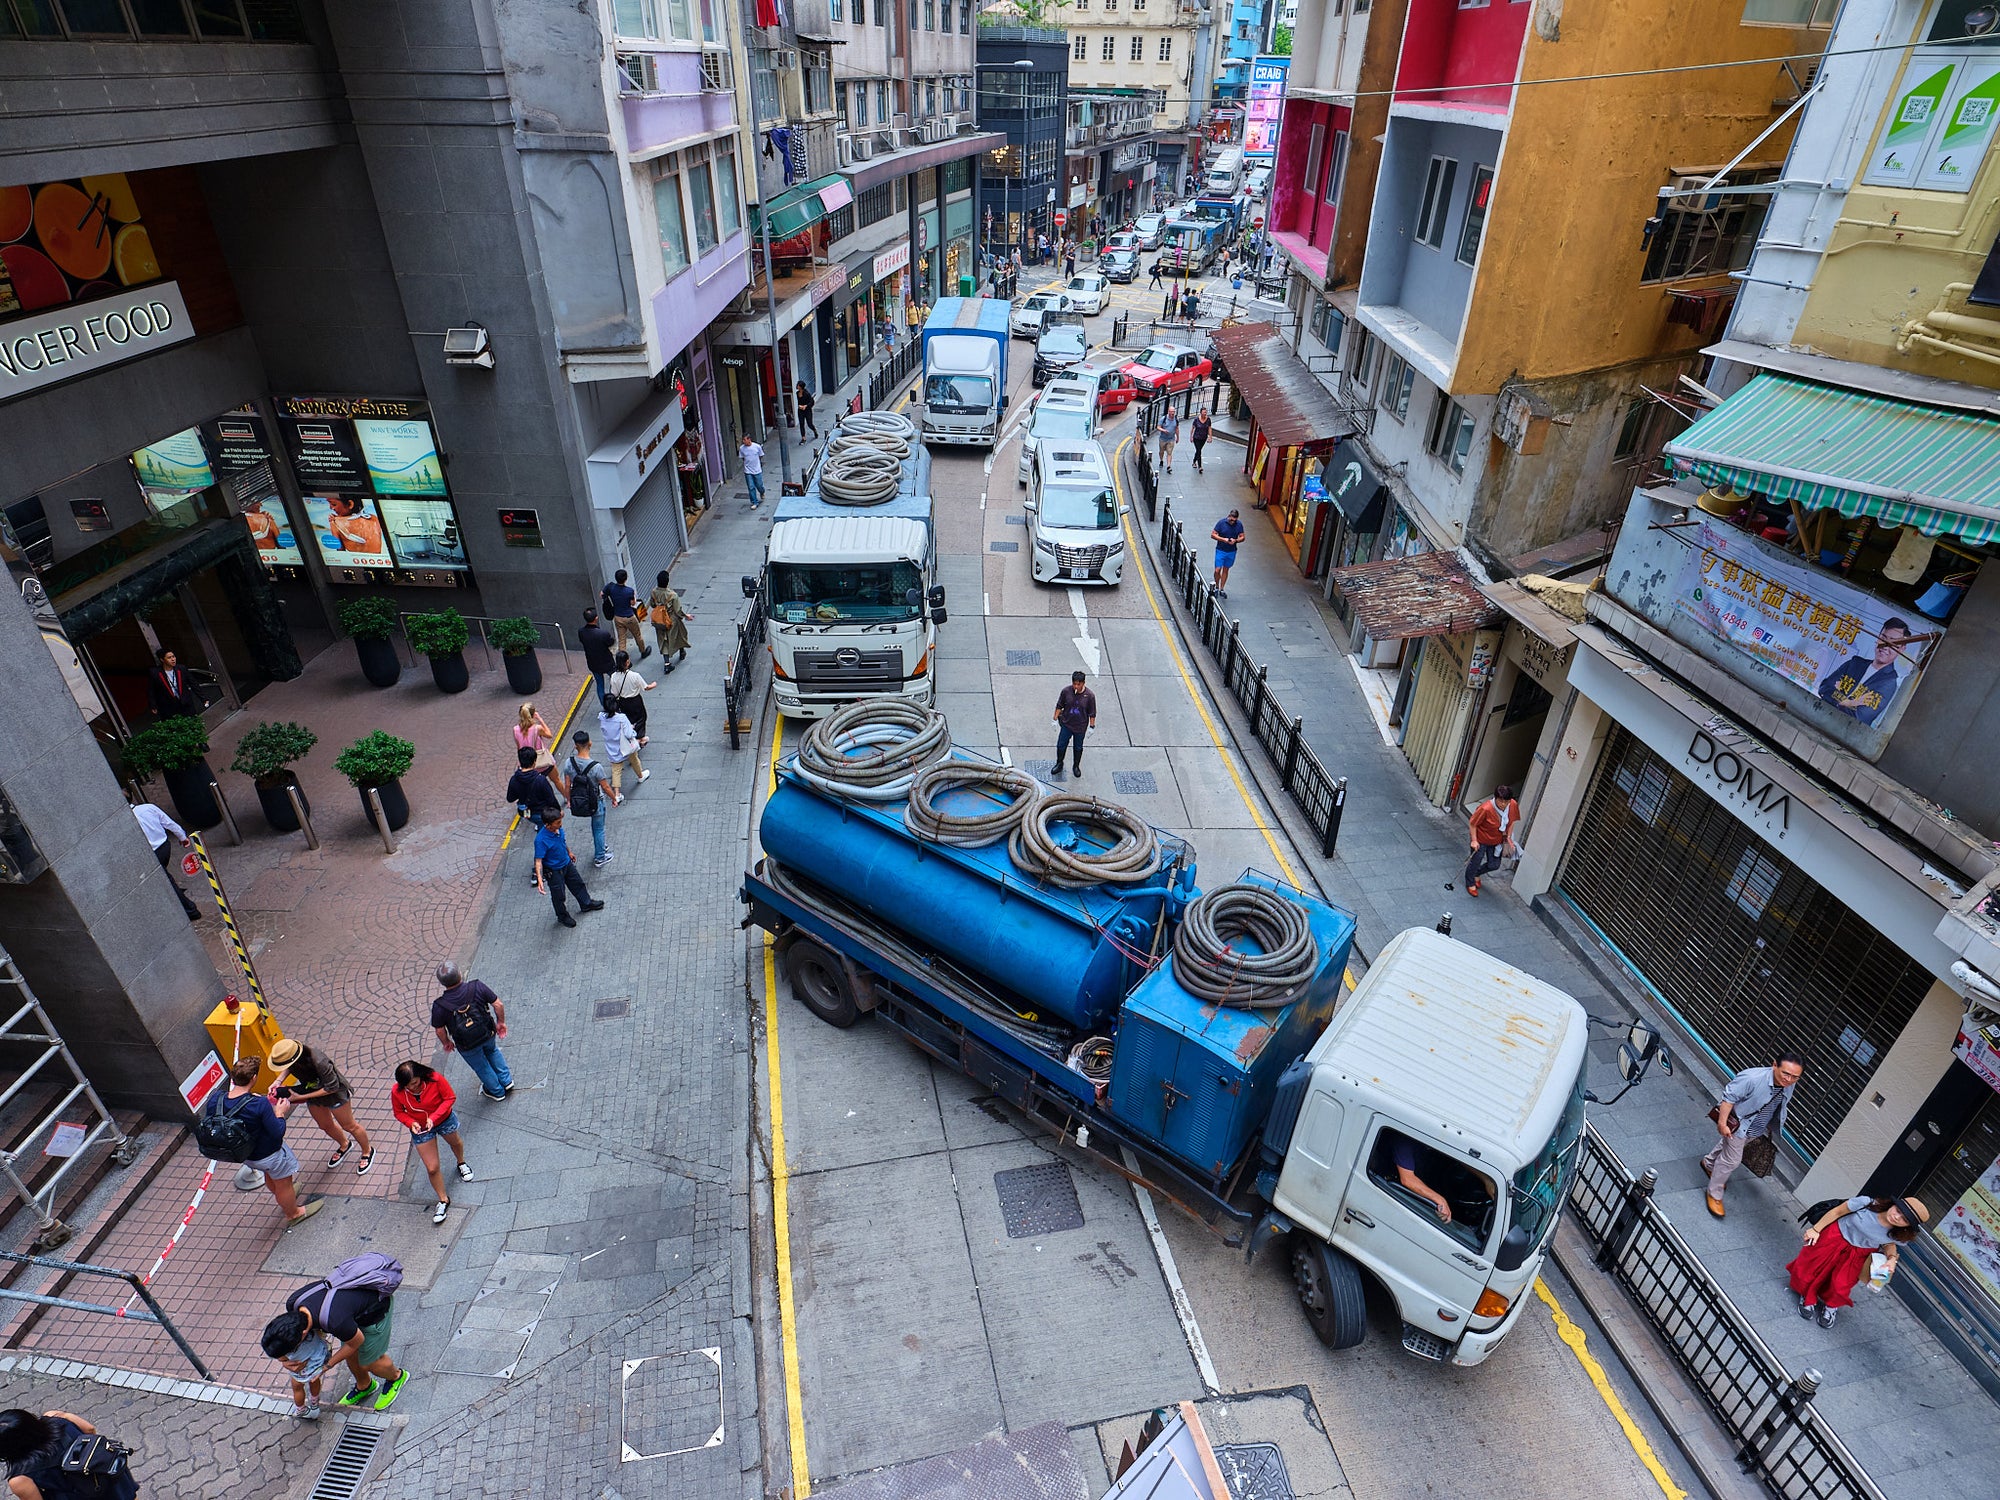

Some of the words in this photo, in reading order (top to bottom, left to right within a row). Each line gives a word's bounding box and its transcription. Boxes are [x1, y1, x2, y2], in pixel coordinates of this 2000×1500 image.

[1255, 67, 1281, 79] CRAIG
[83, 301, 173, 353] FOOD
[351, 402, 409, 416] CENTRE
[1721, 586, 1745, 602] come
[1747, 597, 1756, 608] to
[1782, 616, 1809, 637] Wong
[1809, 630, 1826, 643] for
[1828, 637, 1848, 656] help
[1722, 612, 1748, 630] 4848
[1798, 651, 1819, 670] Wong
[1685, 757, 1786, 840] LIFESTYLE
